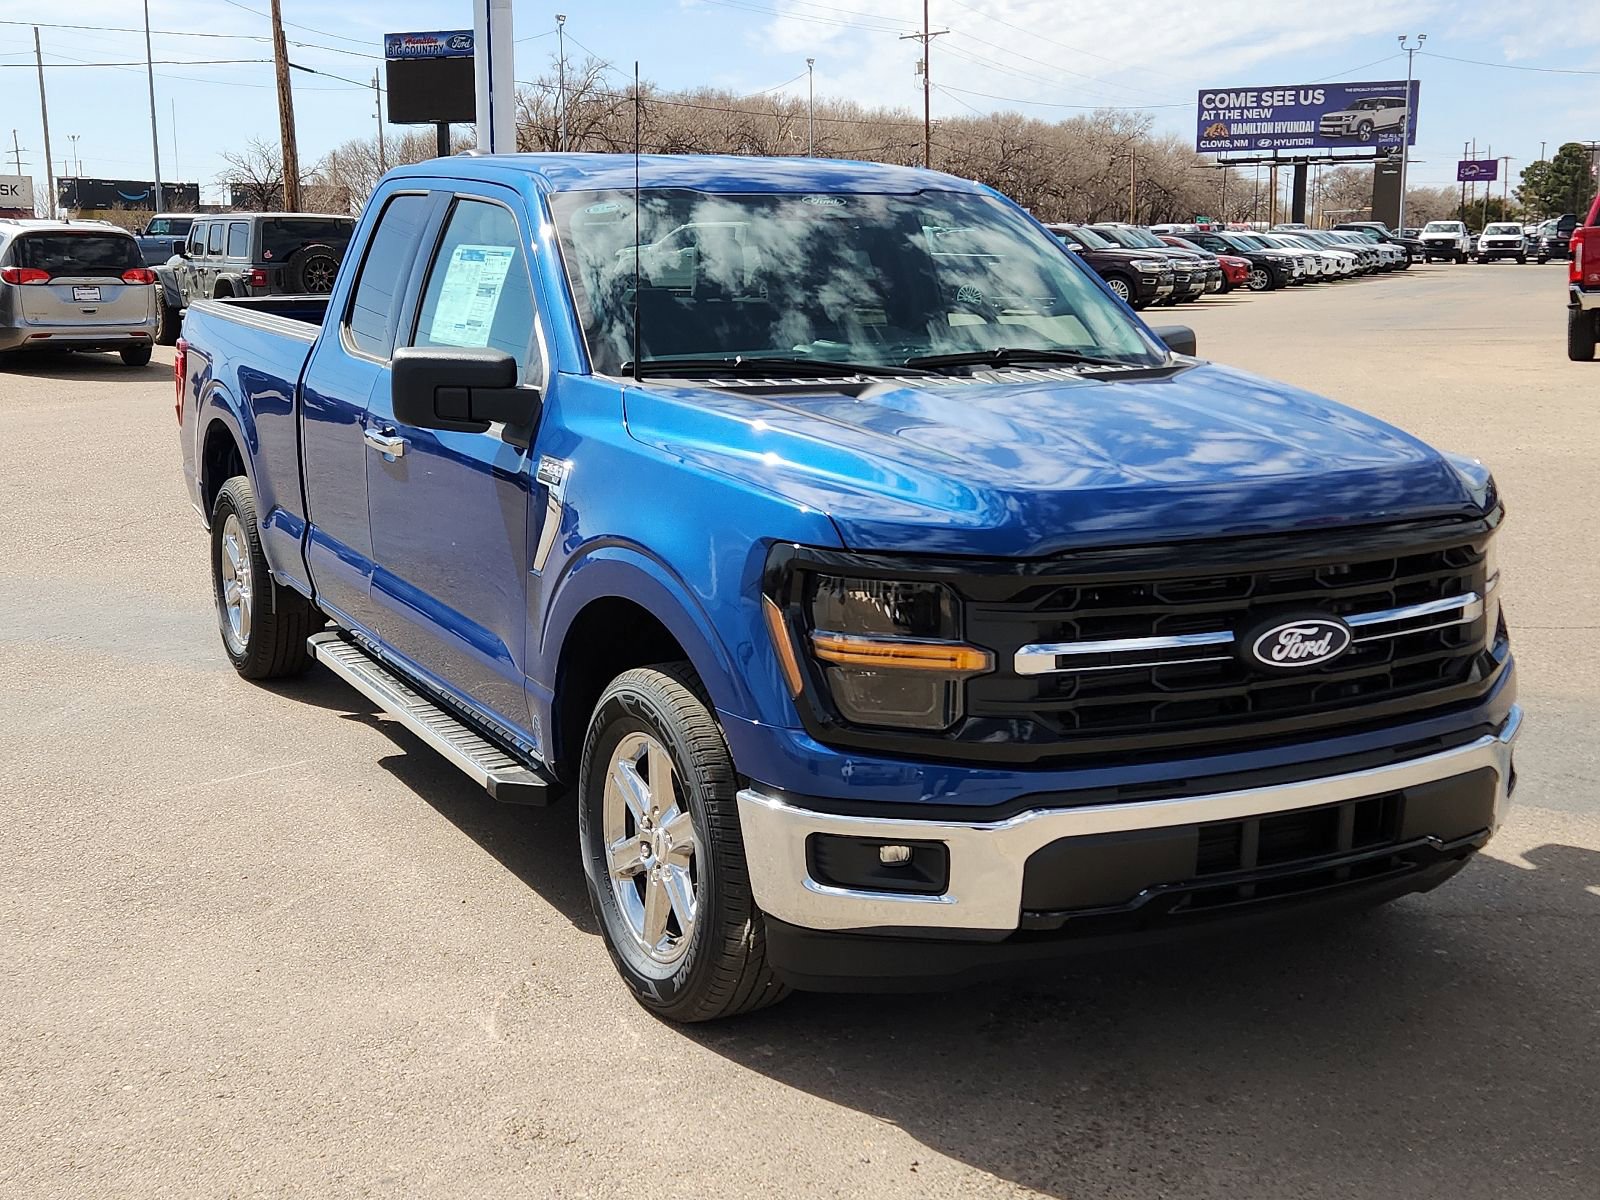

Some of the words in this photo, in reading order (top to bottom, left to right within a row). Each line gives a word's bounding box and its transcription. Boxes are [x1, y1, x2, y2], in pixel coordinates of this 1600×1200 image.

[452, 36, 472, 49] Ford
[388, 46, 402, 56] BIG
[404, 44, 444, 55] COUNTRY
[1201, 92, 1258, 109] COME
[1260, 90, 1296, 107] SEE
[1299, 89, 1325, 106] US
[1201, 110, 1216, 121] AT
[1218, 109, 1241, 120] THE
[1243, 108, 1273, 119] NEW
[1230, 121, 1274, 135] HAMILTON
[1274, 120, 1315, 134] HYUNDAI
[1200, 140, 1232, 148] CLOVIS,
[1233, 139, 1249, 147] NM
[1273, 137, 1314, 146] HYUNDAI
[1271, 626, 1333, 661] Ford
